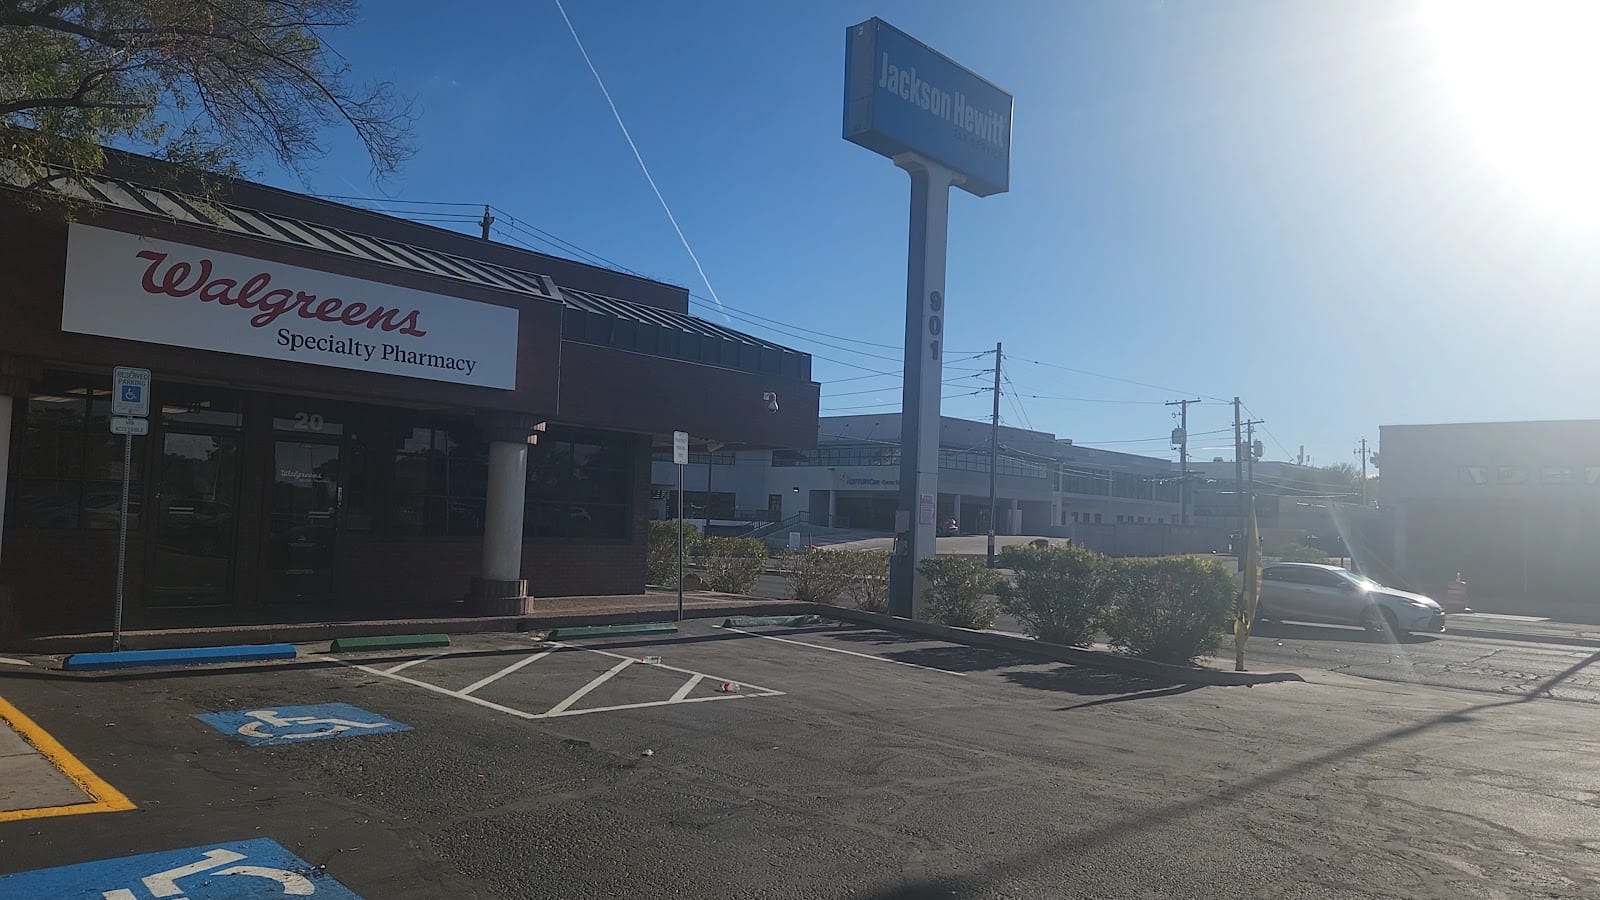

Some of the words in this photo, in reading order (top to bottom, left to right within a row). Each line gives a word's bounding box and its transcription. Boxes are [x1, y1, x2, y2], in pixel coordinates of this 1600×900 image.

[878, 51, 951, 121] Jackson
[953, 91, 1005, 149] Hewitt
[135, 249, 427, 338] Walgreens
[928, 290, 942, 361] 901
[117, 371, 148, 381] RESERVED
[276, 327, 377, 362] Specialty
[380, 343, 477, 376] Pharmacy
[118, 379, 146, 387] PARKING
[294, 412, 324, 431] 20
